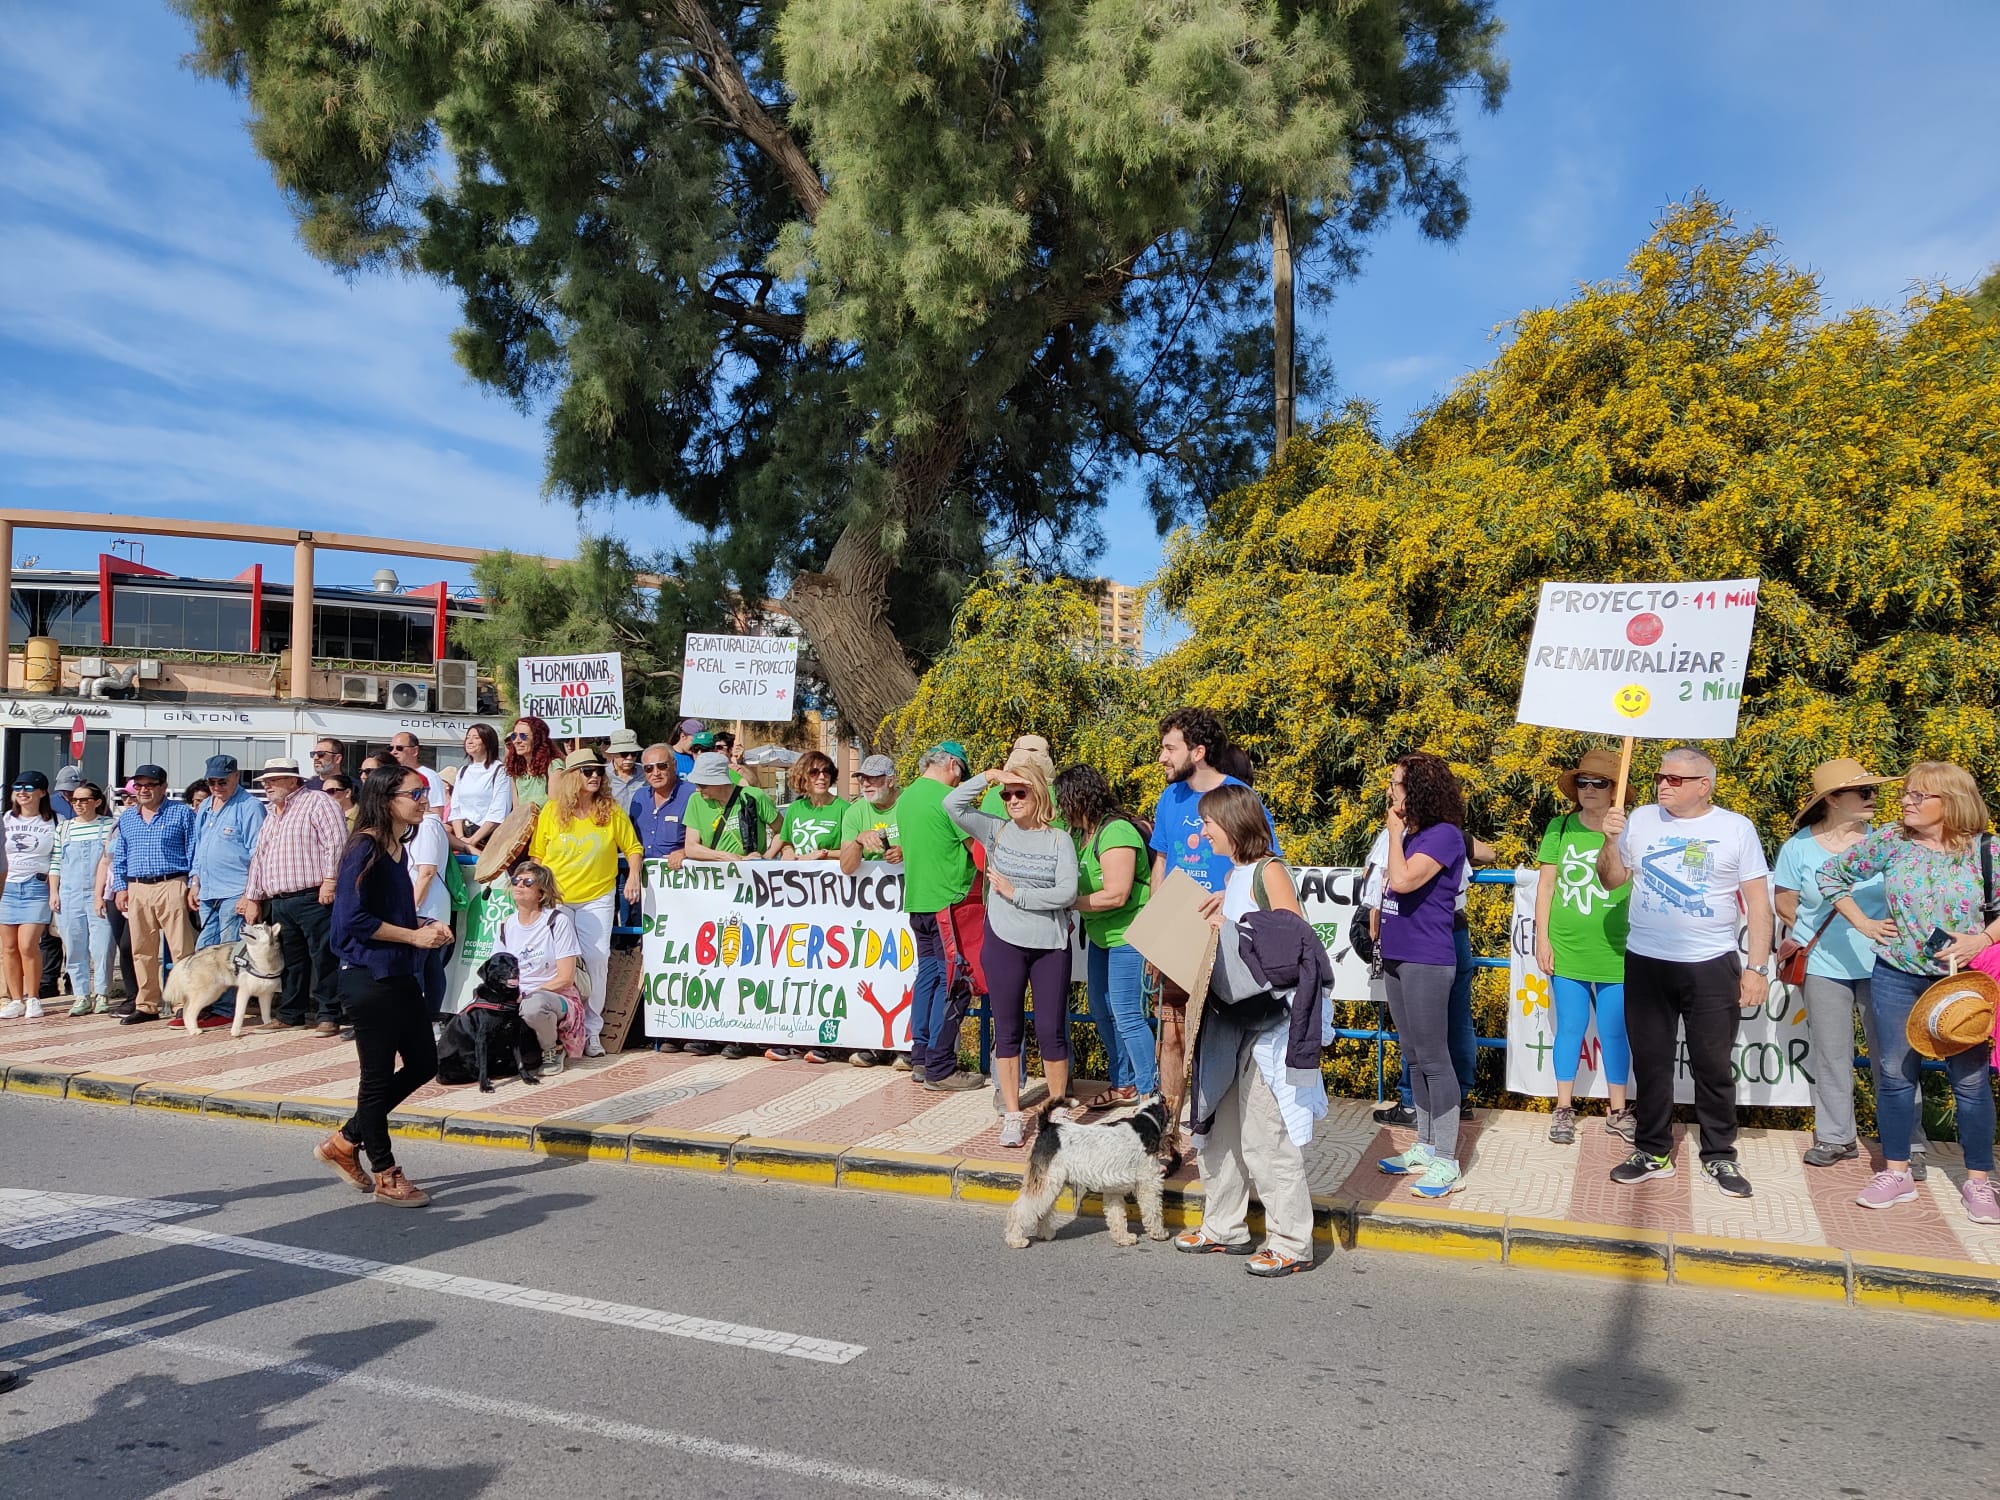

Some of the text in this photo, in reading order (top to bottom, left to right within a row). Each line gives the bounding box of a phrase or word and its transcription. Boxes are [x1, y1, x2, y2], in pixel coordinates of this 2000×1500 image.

[1550, 590, 1679, 613] PROYECTO
[1694, 591, 1716, 610] 11
[687, 636, 789, 655] RENATURALIZACIÓN
[697, 658, 727, 674] REAL
[749, 659, 797, 676] PROYECTO
[1534, 642, 1727, 674] RENATURALIZAR
[531, 660, 610, 683] HORMIGONAR
[560, 682, 590, 698] NO
[719, 679, 768, 696] GRATIS
[1679, 680, 1693, 702] 2
[529, 693, 619, 718] RENATURALIZAR
[163, 711, 250, 724] GIN TONIC
[642, 858, 725, 891] FRENTE
[727, 861, 742, 879] A
[733, 882, 754, 905] LA
[642, 913, 668, 938] DE
[662, 940, 689, 965] LA
[644, 968, 726, 1013] ACCIÓN
[737, 977, 847, 1020] POLÍTICA
